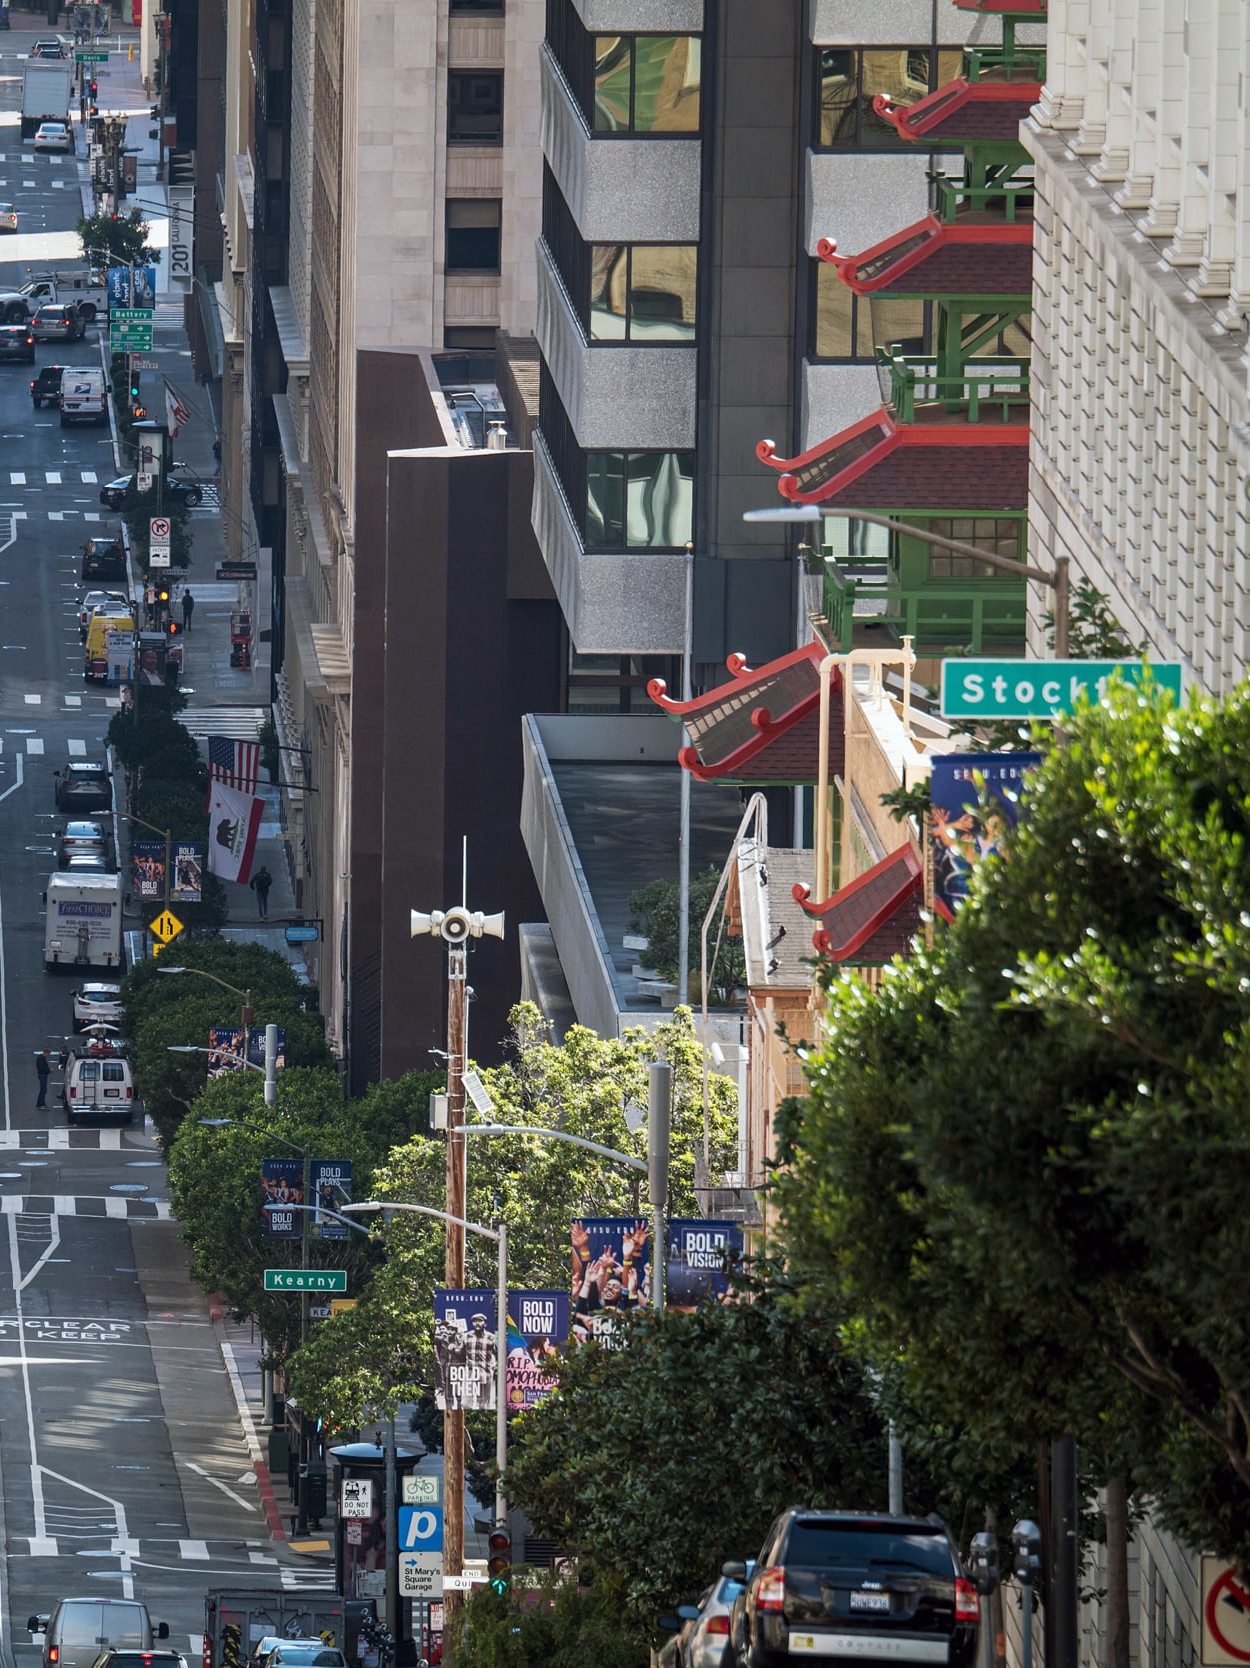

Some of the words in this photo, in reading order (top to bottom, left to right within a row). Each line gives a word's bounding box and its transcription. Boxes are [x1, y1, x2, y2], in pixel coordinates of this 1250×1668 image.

[171, 201, 181, 243] CALIFORNIA
[172, 243, 189, 273] 201
[115, 311, 148, 319] Battery
[961, 673, 1166, 704] Stockt
[178, 847, 195, 855] BOLD
[141, 881, 158, 889] BOLD
[320, 1167, 341, 1177] BOLD
[320, 1177, 341, 1186] PLAYS
[271, 1212, 293, 1223] BOLD
[271, 1223, 293, 1231] WORKS
[686, 1232, 725, 1253] BOLD
[686, 1253, 725, 1268] VISION
[273, 1274, 336, 1288] Kearny
[522, 1300, 554, 1317] BOLD
[23, 1320, 131, 1332] CLEAR
[523, 1317, 553, 1334] NOW
[37, 1330, 122, 1341] KEEP
[450, 1366, 480, 1381] BOLD
[450, 1381, 481, 1397] THEN
[404, 1567, 413, 1575] St
[414, 1567, 441, 1577] Mary's
[404, 1576, 432, 1584] Square
[862, 1580, 880, 1589] Jeep
[404, 1583, 433, 1591] Garage
[430, 1604, 440, 1612] NO
[837, 1639, 901, 1650] COMPASS
